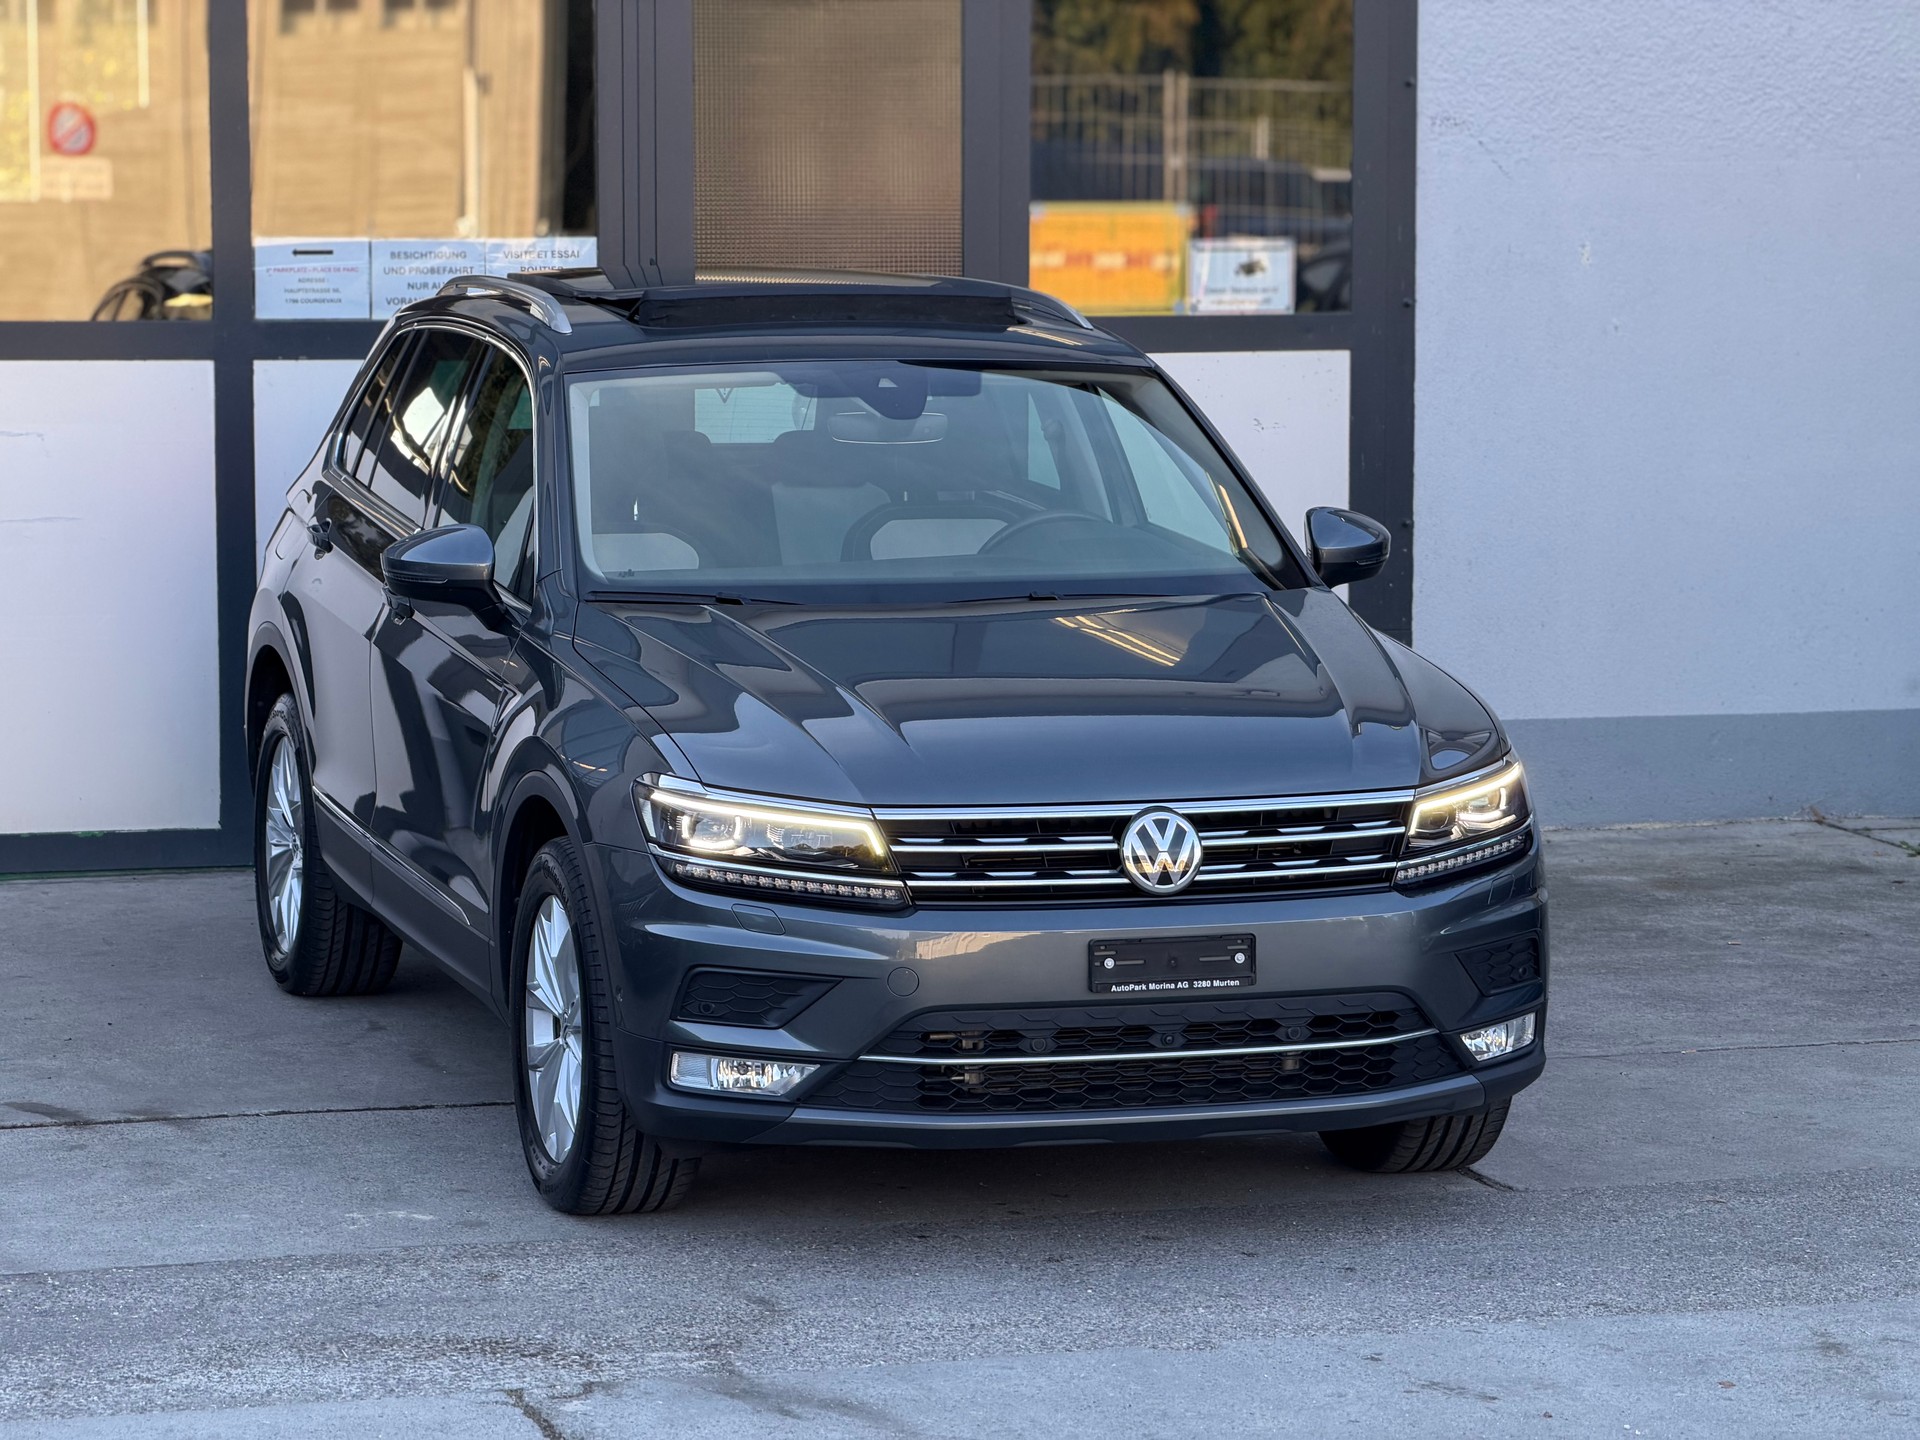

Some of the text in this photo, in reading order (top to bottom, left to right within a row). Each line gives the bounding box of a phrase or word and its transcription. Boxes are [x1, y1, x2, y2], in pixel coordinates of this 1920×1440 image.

[390, 251, 467, 260] BESICHTIGUNG
[503, 250, 580, 259] VISITE ET ESSAI
[383, 266, 475, 275] UND PROBEFAHRT
[407, 282, 430, 290] NUR
[1110, 979, 1240, 992] AutoPark Morina AG 3280 Murten
